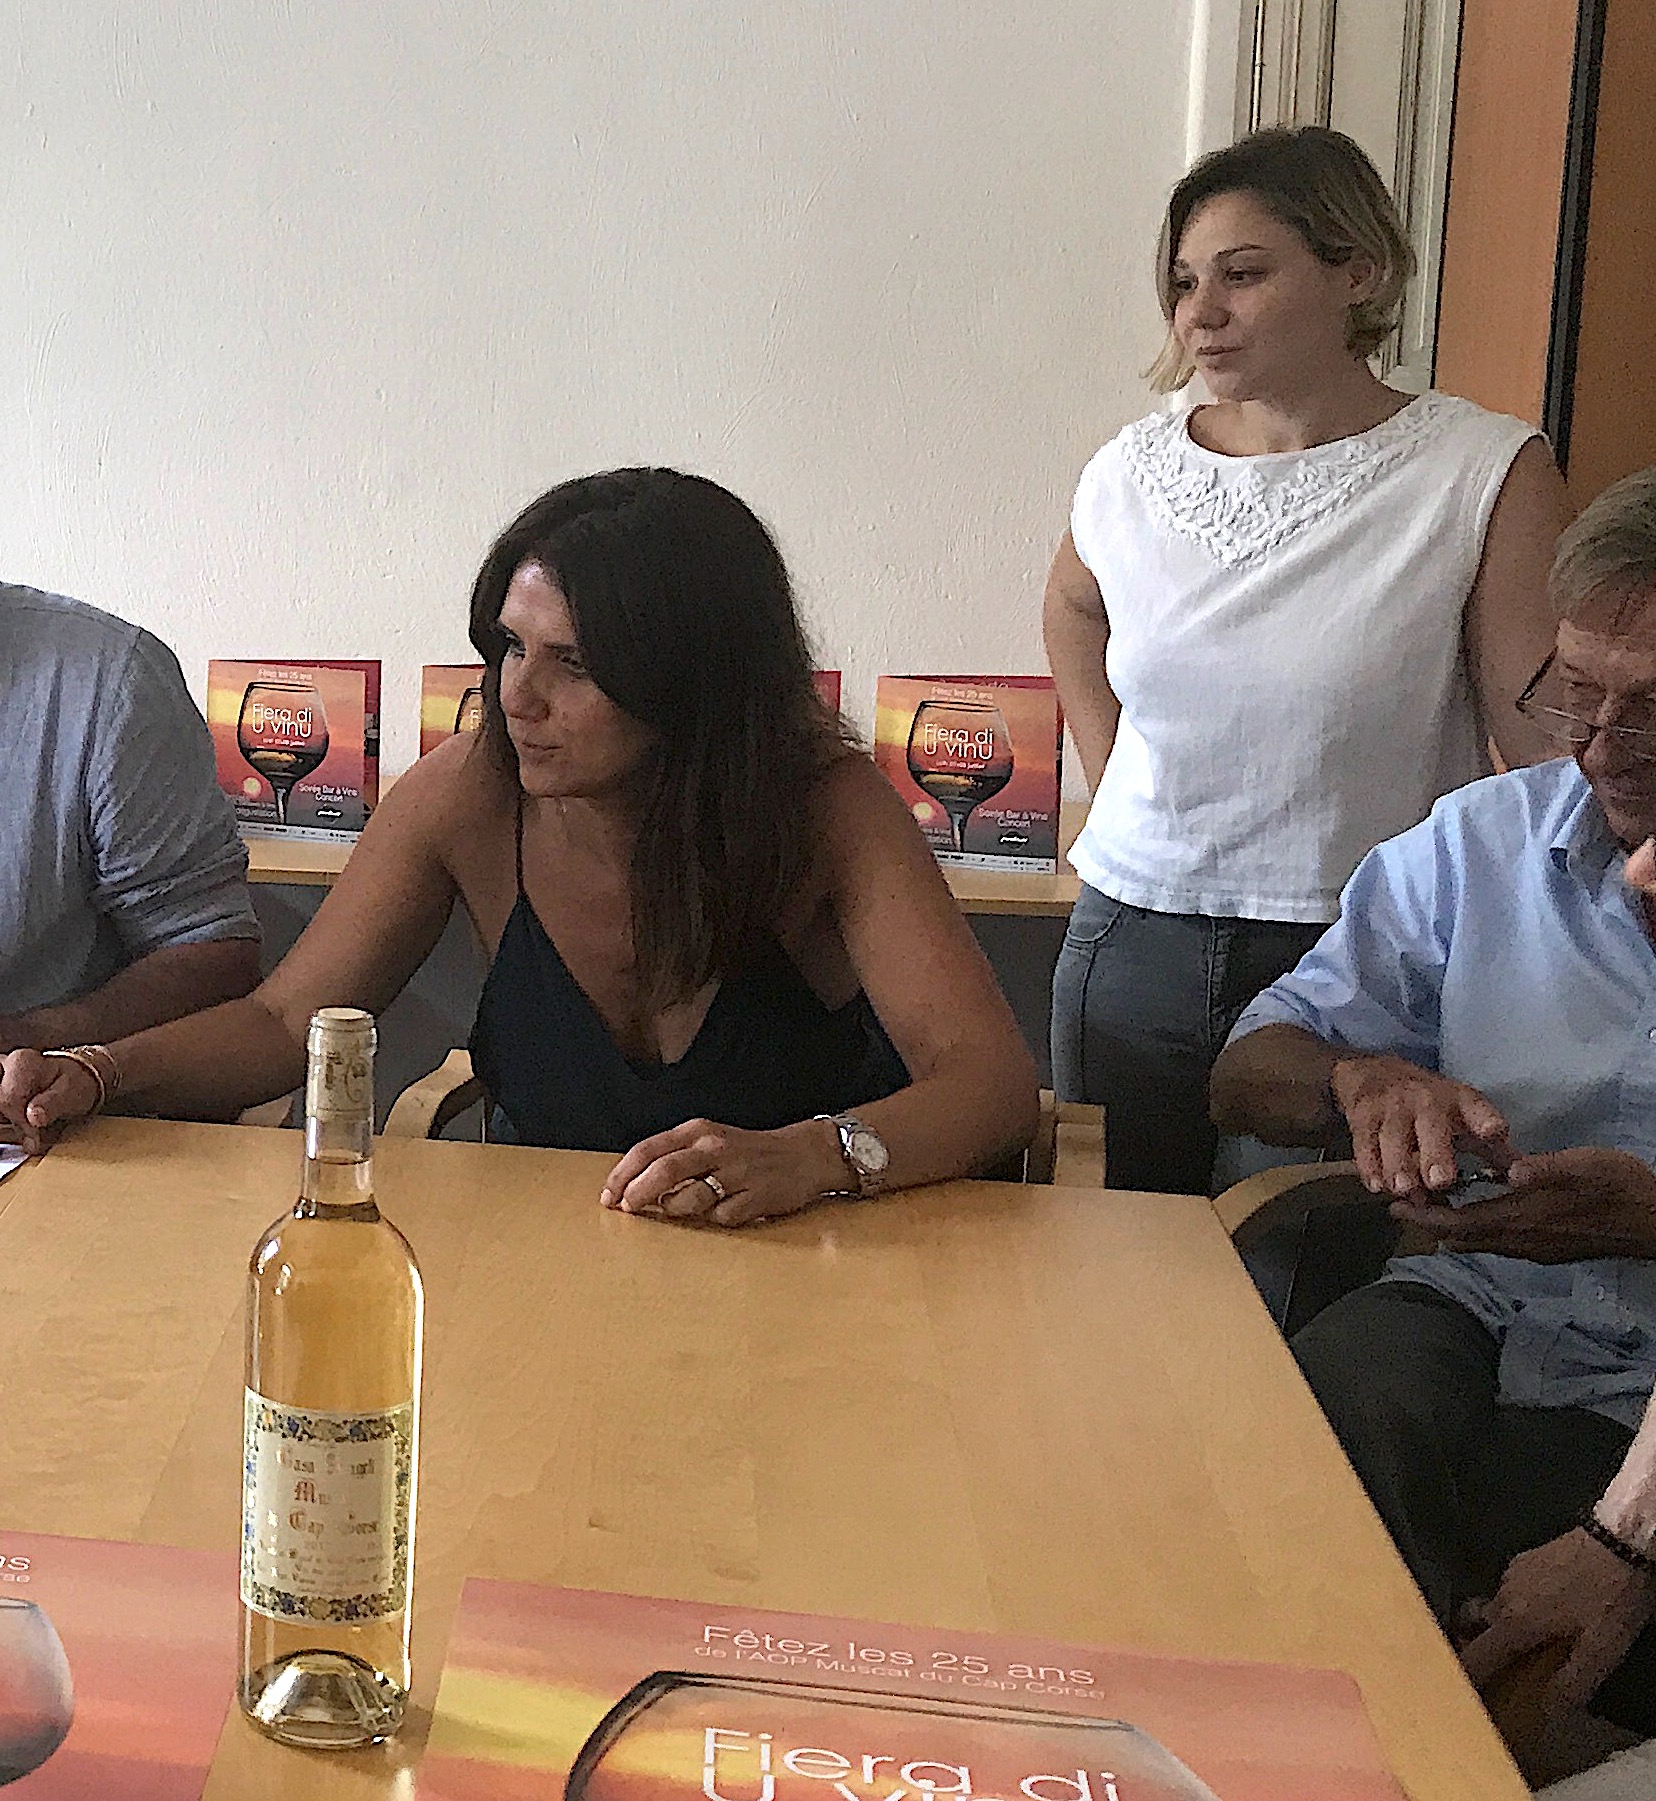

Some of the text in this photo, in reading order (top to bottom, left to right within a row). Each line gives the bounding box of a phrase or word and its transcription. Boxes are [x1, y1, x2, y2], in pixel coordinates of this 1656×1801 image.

[252, 703, 312, 723] Fiera di
[270, 722, 312, 738] vinu
[924, 723, 994, 745] Fiera di
[945, 741, 994, 760] vinu
[703, 1624, 1096, 1685] Fêtez les 25 ans
[694, 1645, 1106, 1700] de l'AOP Muscat du Cap Corse
[704, 1726, 973, 1796] Fiera
[1019, 1769, 1120, 1801] di
